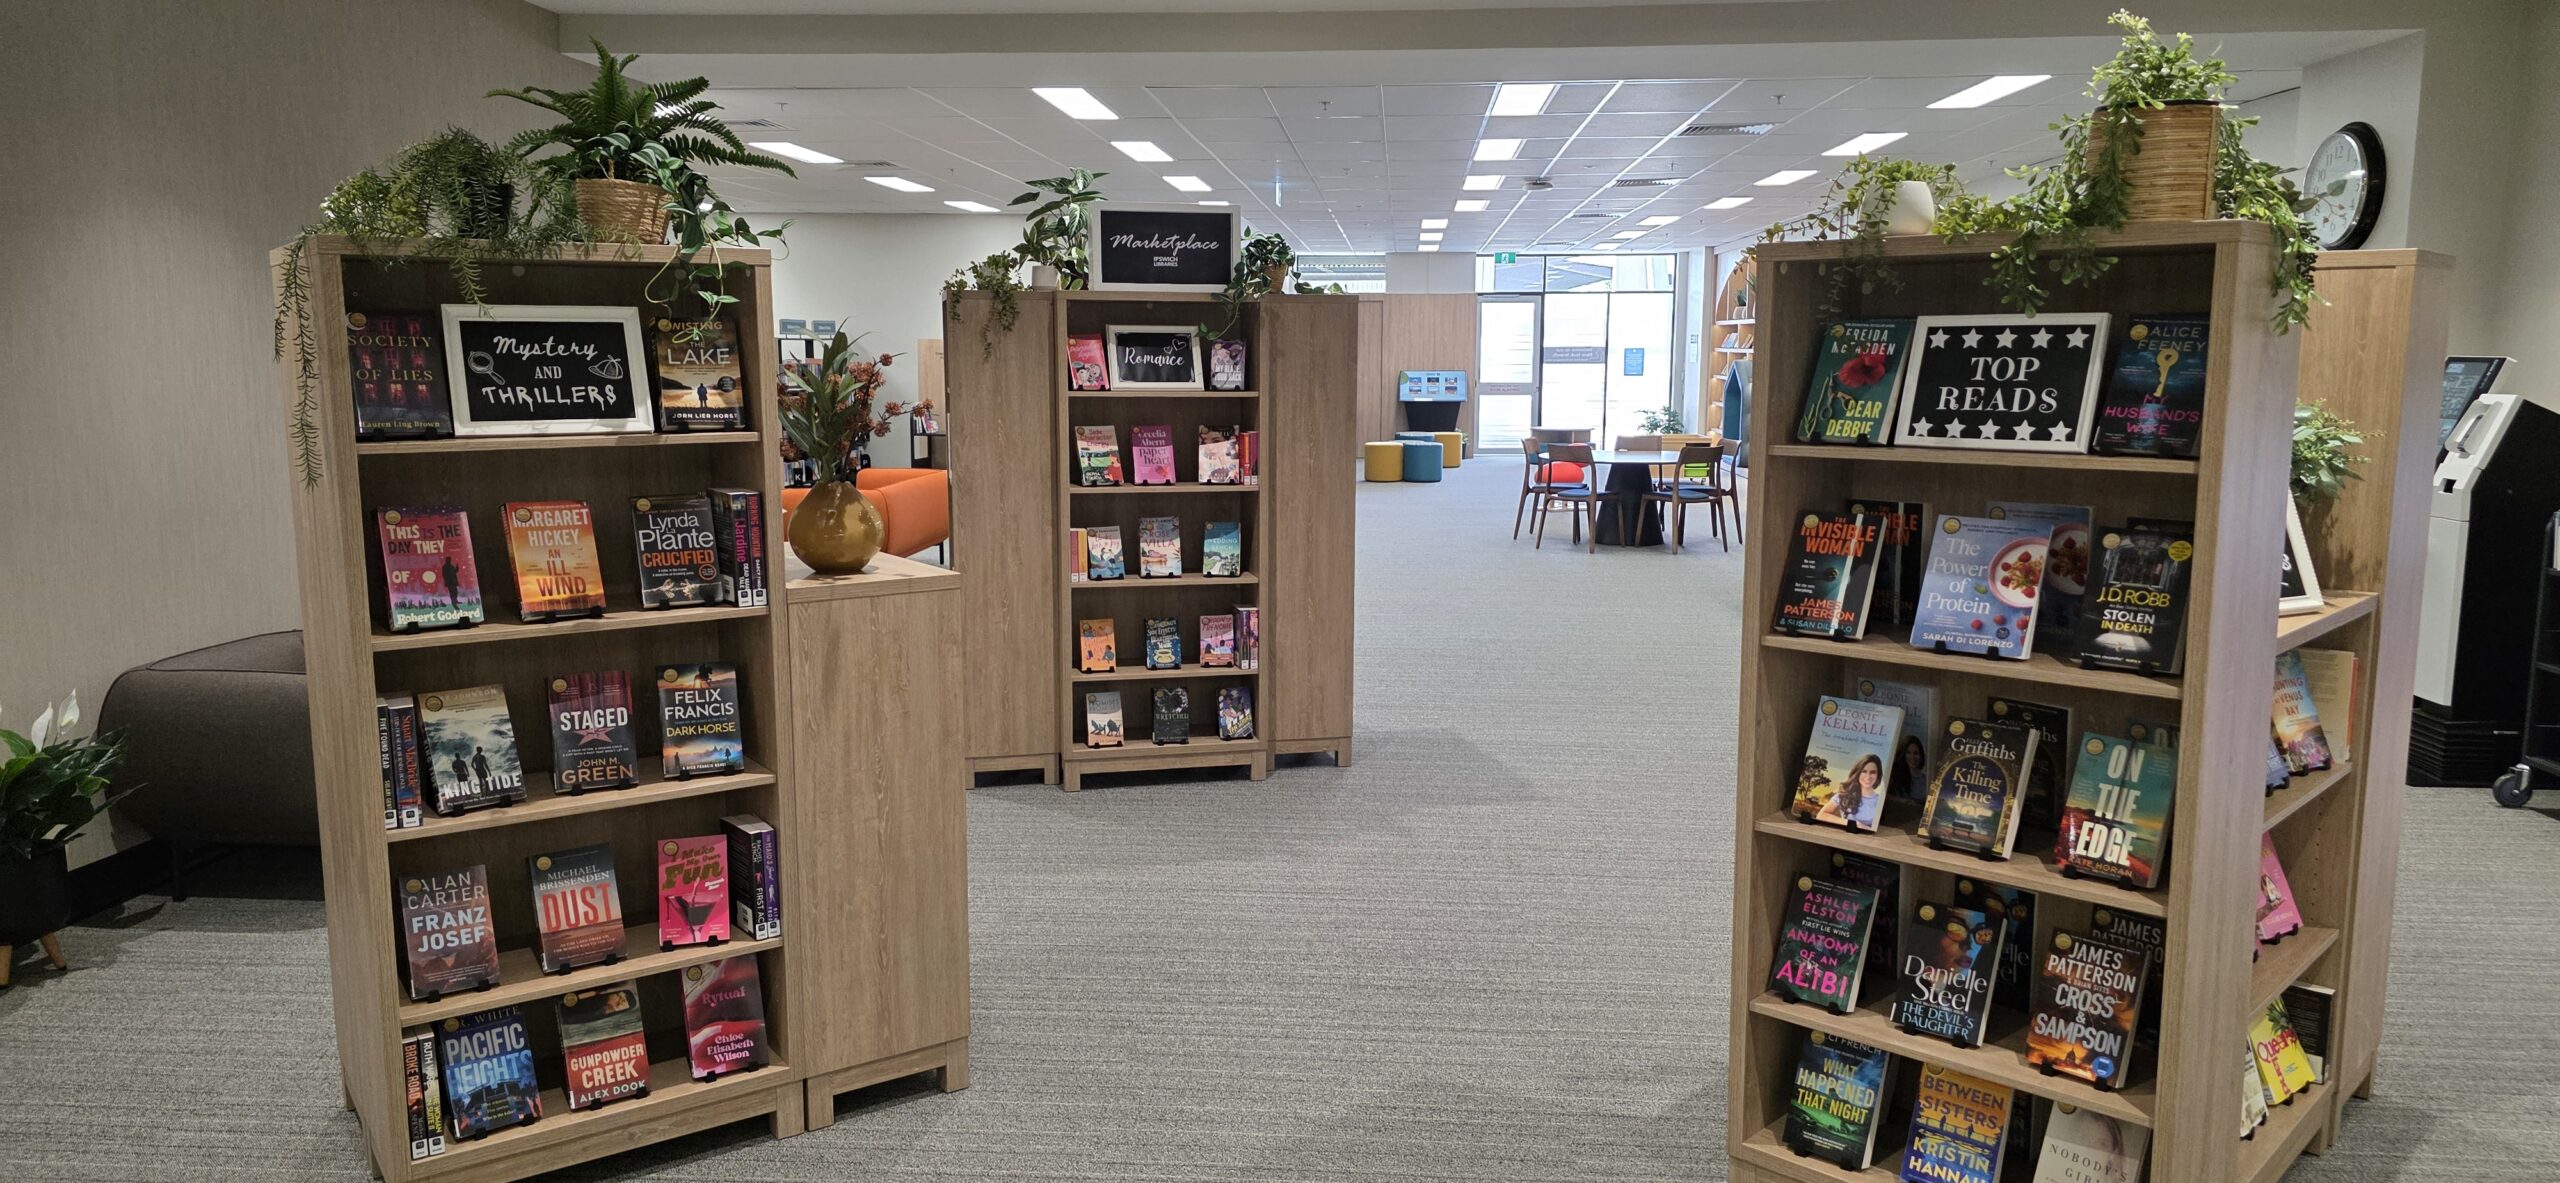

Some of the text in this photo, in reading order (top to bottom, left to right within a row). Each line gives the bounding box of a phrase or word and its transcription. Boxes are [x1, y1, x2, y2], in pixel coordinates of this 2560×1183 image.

[1110, 233, 1219, 256] Marketplace
[347, 335, 432, 348] SOCIETY
[1846, 329, 1888, 341] FREIDA
[2150, 326, 2202, 338] ALICE
[493, 335, 598, 361] Mystery
[2137, 339, 2206, 352] FEENEY
[667, 348, 731, 365] LAKE
[1125, 347, 1184, 366] Romance
[356, 370, 433, 381] OF LIES
[534, 366, 562, 379] AND
[1970, 356, 2040, 382] TOP
[482, 385, 617, 412] THRILLERS
[1935, 386, 2058, 414] READS
[1846, 400, 1882, 418] DEAR
[2104, 406, 2200, 423] HUSBAND'S
[362, 420, 440, 430] Lauren Ling Brown
[1138, 429, 1167, 438] Cecelia
[1826, 419, 1874, 438] DEBBIE
[2126, 422, 2169, 435] WIFE
[1139, 447, 1167, 457] paper
[1140, 438, 1165, 446] Ahern
[512, 509, 589, 527] MARGARET
[649, 512, 699, 533] Lynda
[386, 525, 460, 539] THIS IS THE
[528, 529, 579, 547] HICKEY
[639, 529, 714, 551] Plante
[735, 520, 747, 563] Jardine
[1801, 522, 1876, 542] INVISIBLE
[388, 540, 445, 554] DAY THEY
[548, 549, 560, 559] AN
[1806, 537, 1865, 557] WOMAN
[1947, 537, 1980, 556] The
[547, 560, 571, 576] ILL
[642, 550, 715, 568] CRUCIFIED
[1932, 557, 1987, 576] Power
[392, 571, 411, 584] OF
[536, 576, 587, 597] WIND
[1950, 577, 1972, 594] of
[1800, 598, 1842, 609] JAMES
[1926, 592, 1990, 614] Protein
[2096, 587, 2171, 607] J.D. ROBB
[396, 608, 480, 624] Robert Goddard
[1784, 605, 1855, 621] PATTERSON
[1787, 618, 1815, 628] SUSAN
[2102, 609, 2155, 624] STOLEN
[2101, 620, 2153, 634] IN DEATH
[1922, 632, 1954, 641] SARAH
[1968, 638, 2014, 649] LORENZO
[675, 688, 721, 704] FELIX
[560, 707, 629, 731] STAGED
[664, 702, 734, 720] FRANCIS
[1838, 709, 1880, 722] LEONIE
[667, 722, 736, 737] DARK HORSE
[1823, 716, 1887, 736] KELSALL
[1951, 737, 2016, 760] Griffiths
[382, 752, 390, 769] DEAD
[577, 756, 620, 768] JOHN M.
[1972, 760, 1987, 770] The
[2107, 745, 2145, 782] ON
[561, 764, 633, 784] GREEN
[1952, 767, 2003, 792] Killing
[443, 774, 522, 798] KING TIDE
[1955, 783, 1992, 804] Time
[2094, 782, 2141, 824] THE
[2075, 820, 2137, 866] EDGE
[547, 865, 600, 880] MICHAEL
[663, 861, 723, 890] Fun
[2096, 862, 2132, 877] HORAN
[422, 872, 470, 892] ALAN
[540, 871, 609, 891] BRISSENDEN
[408, 885, 485, 910] CARTER
[1805, 892, 1860, 912] ASHLEY
[542, 883, 611, 933] DUST
[1803, 903, 1857, 924] ELSTON
[411, 906, 486, 933] FRANZ
[1801, 920, 1850, 938] FIRST LIE WINS
[417, 926, 485, 952] JOSEF
[2110, 917, 2162, 944] JAMES
[1787, 928, 1859, 956] ANATOMY
[1800, 949, 1838, 966] OF AN
[2068, 942, 2123, 970] JAMES
[1776, 960, 1848, 998] ALIBI
[1904, 955, 1988, 993] Danielle
[2048, 954, 2136, 994] PATTERSON
[702, 986, 746, 1007] Rytual
[1911, 972, 1972, 1012] Steel
[2055, 983, 2114, 1018] CROSS
[475, 1005, 520, 1024] WHITE
[1903, 1001, 1974, 1029] THE DEVIL'S
[2075, 1011, 2086, 1024] &
[1901, 1012, 1968, 1040] DAUGHTER
[2035, 1013, 2122, 1057] SAMPSON
[445, 1023, 525, 1066] PACIFIC
[707, 1039, 754, 1056] Elisabeth
[715, 1032, 744, 1044] Chloe
[423, 1042, 433, 1064] RUTH
[570, 1044, 644, 1071] GUNPOWDER
[713, 1049, 749, 1063] Wilson
[405, 1044, 424, 1106] BROKE ROAD
[446, 1050, 532, 1093] HEIGHTS
[581, 1059, 639, 1089] CREEK
[1823, 1058, 1858, 1078] WHAT
[580, 1080, 646, 1103] ALEX DOOK
[1796, 1067, 1875, 1109] HAPPENED
[1924, 1075, 2004, 1110] BETWEEN
[1796, 1088, 1869, 1125] THAT NIGHT
[1922, 1095, 2000, 1130] SISTERS
[1913, 1136, 1990, 1174] KRISTIN
[2049, 1143, 2128, 1182] NOBODY'S
[1909, 1156, 1986, 1183] HANNAH
